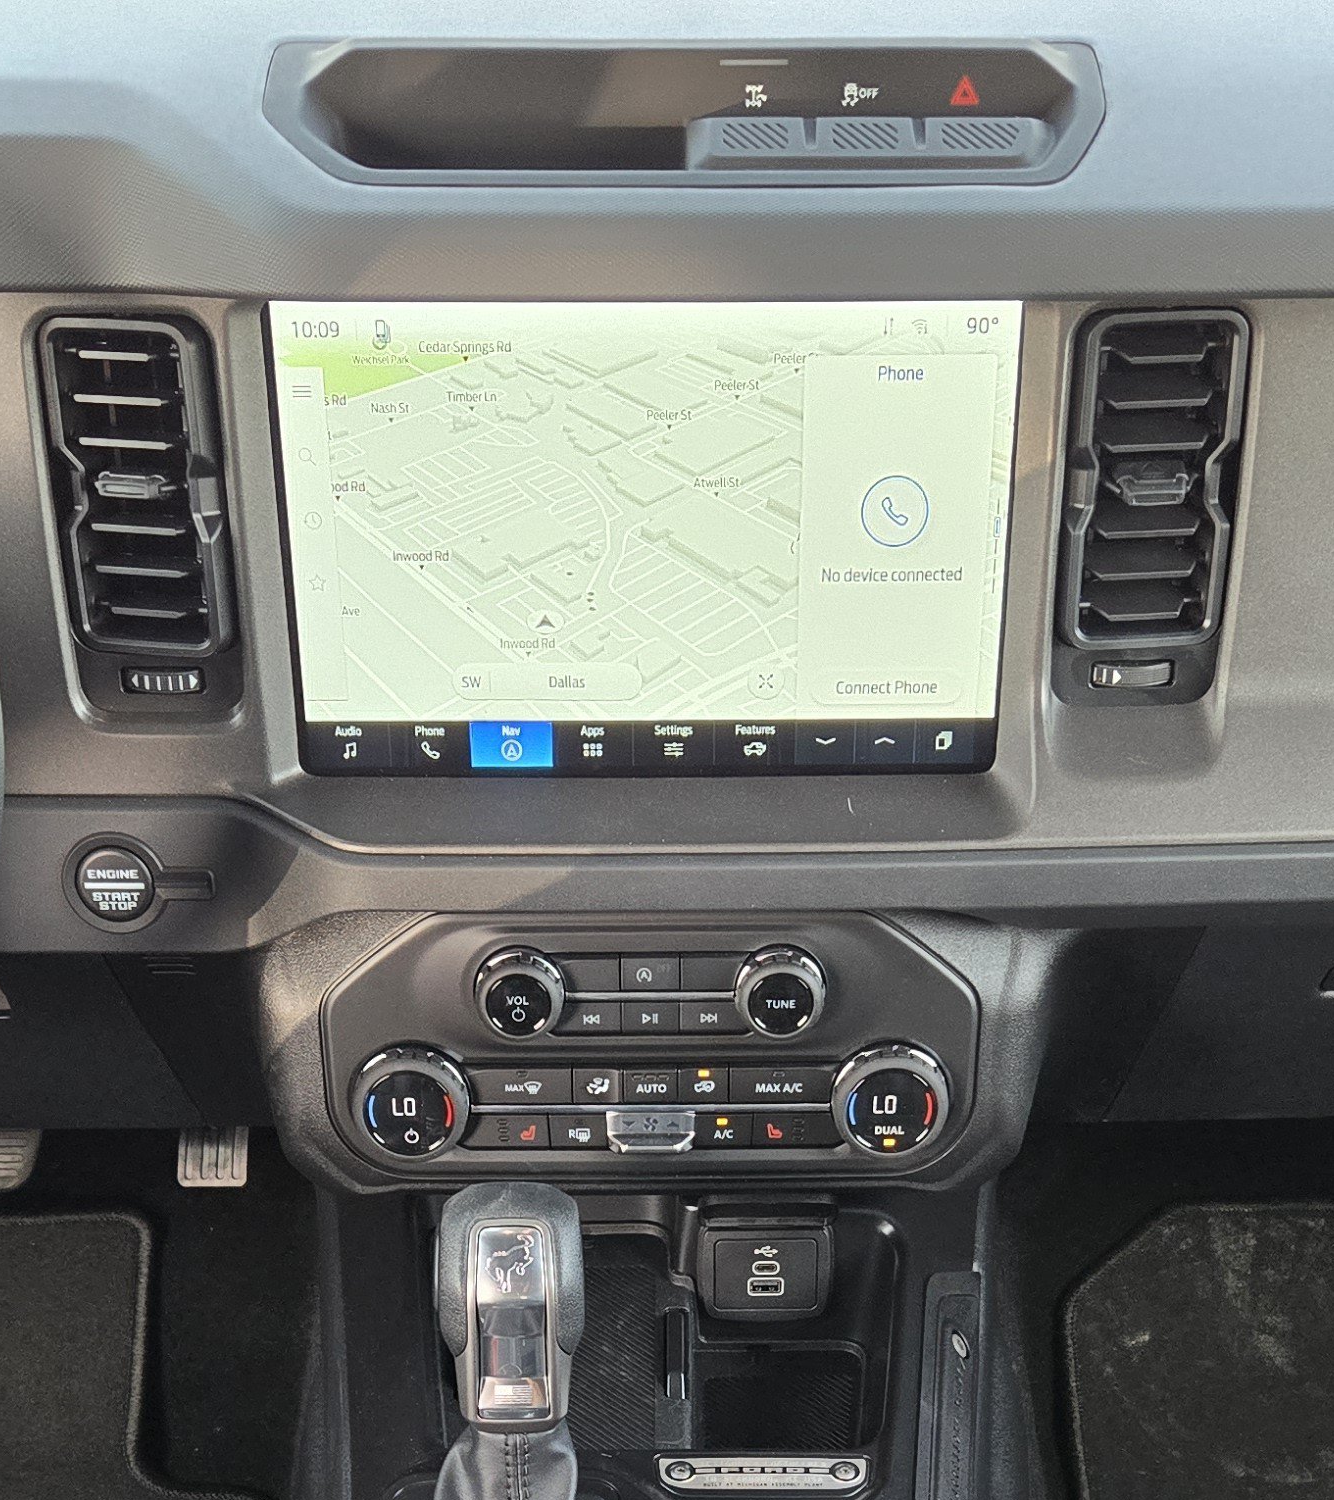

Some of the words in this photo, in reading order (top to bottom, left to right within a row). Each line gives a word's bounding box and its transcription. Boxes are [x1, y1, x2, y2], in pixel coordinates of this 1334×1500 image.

[858, 87, 879, 100] OFF
[291, 321, 340, 338] 10:09
[966, 317, 999, 334] 90°
[418, 341, 451, 352] Cedar
[453, 341, 494, 354] Springs
[496, 341, 512, 352] Rd
[390, 355, 410, 364] Park
[774, 353, 806, 364] Peeler
[878, 366, 924, 381] Phone
[714, 380, 746, 391] Peeler
[748, 380, 760, 390] St
[332, 394, 346, 406] Rd
[446, 392, 480, 402] Timber
[482, 392, 496, 402] Ln
[371, 403, 396, 414] Nash
[400, 403, 410, 413] St
[646, 410, 678, 421] Peeler
[680, 410, 692, 420] St
[351, 481, 366, 492] Rd
[694, 477, 726, 488] Atwell
[728, 477, 740, 488] St
[392, 551, 432, 562] Inwood
[434, 551, 449, 562] Rd
[821, 568, 841, 583] No
[844, 568, 888, 582] device
[890, 566, 963, 582] connected
[342, 606, 360, 616] Ave
[500, 638, 539, 649] Inwood
[541, 638, 556, 648] Rd
[461, 676, 482, 688] SW
[548, 676, 586, 688] Dallas
[836, 680, 892, 695] Connect
[894, 680, 938, 694] Phone
[335, 726, 362, 737] Audio
[414, 726, 445, 737] Phone
[502, 726, 520, 736] Nav
[580, 726, 604, 738] Apps
[654, 724, 693, 738] Settings
[735, 724, 776, 736] Features
[86, 869, 140, 880] ENGINE
[92, 892, 140, 902] START
[98, 901, 138, 911] STOP
[506, 996, 530, 1006] VOL
[765, 1000, 796, 1009] TUNE
[504, 1084, 524, 1092] MAX
[636, 1084, 667, 1094] AUTO
[756, 1083, 780, 1093] MAX
[783, 1083, 803, 1094] A/C
[714, 1129, 734, 1140] A/C
[874, 1125, 904, 1136] DUAL
